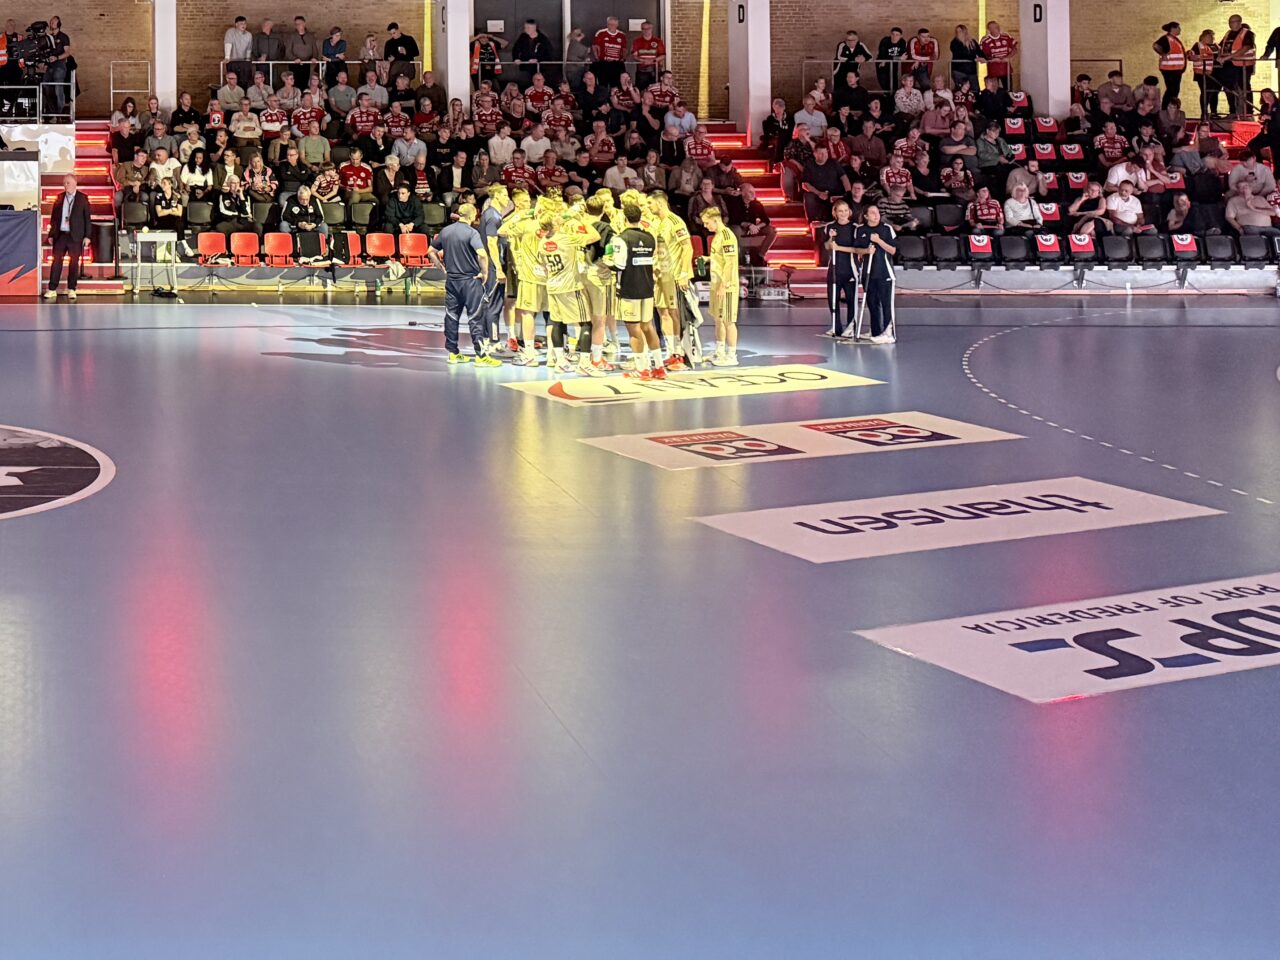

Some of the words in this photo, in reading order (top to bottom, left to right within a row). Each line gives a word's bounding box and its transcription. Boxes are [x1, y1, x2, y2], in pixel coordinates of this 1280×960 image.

[738, 3, 745, 24] D
[1033, 3, 1043, 23] D
[793, 492, 1114, 536] thansen
[1156, 595, 1202, 608] OF
[1198, 583, 1280, 602] PORT
[961, 601, 1158, 635] FREDERICIA
